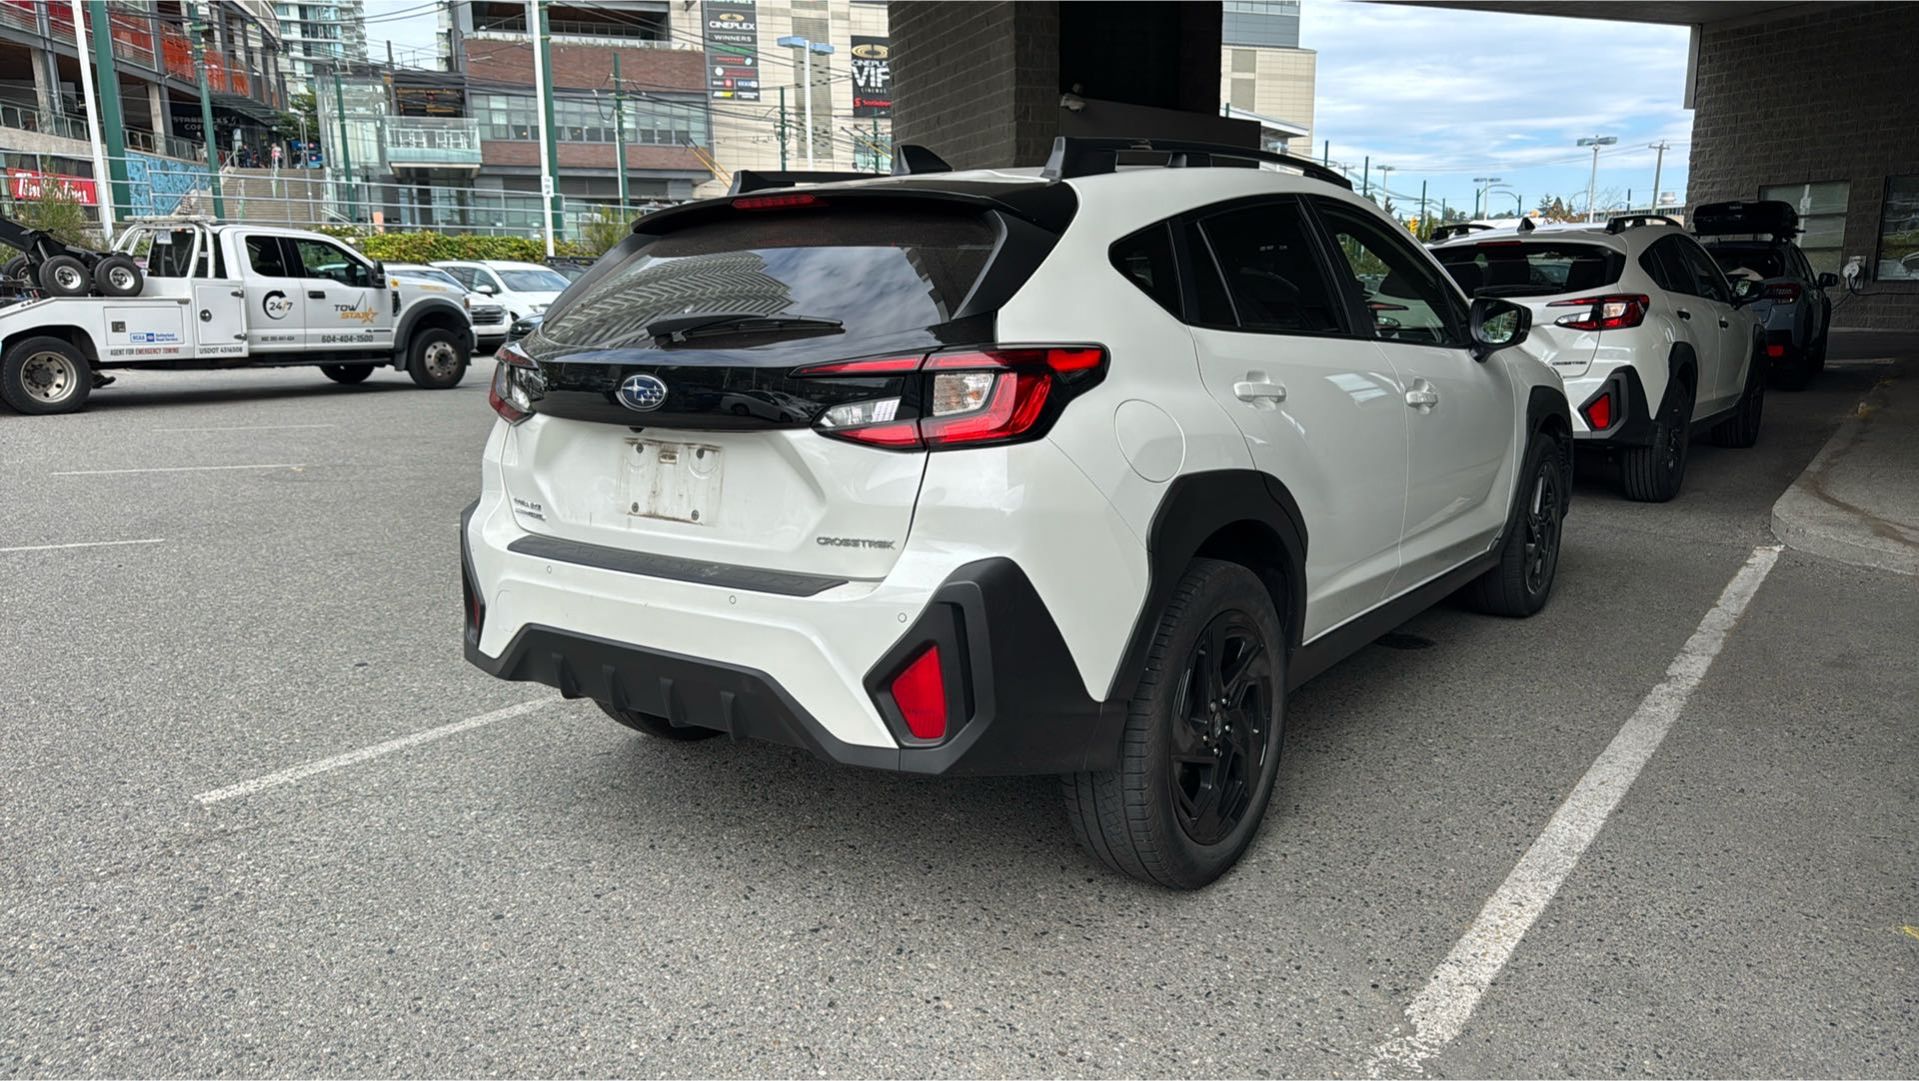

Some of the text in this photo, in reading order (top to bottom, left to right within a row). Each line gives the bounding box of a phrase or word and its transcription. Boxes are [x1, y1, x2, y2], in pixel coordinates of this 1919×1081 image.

[709, 21, 755, 30] CINEPLEX
[713, 34, 752, 42] WINNERS
[851, 59, 889, 68] CINEPLE
[173, 115, 229, 125] STARBKS
[184, 123, 218, 131] COFE
[15, 172, 41, 198] Tim
[269, 301, 293, 312] 24/7
[334, 303, 358, 313] TOW
[321, 335, 374, 343] 604-404-1500
[110, 348, 124, 356] AGENT
[135, 347, 162, 355] EMERGENCY
[816, 537, 896, 550] CROSSTREK
